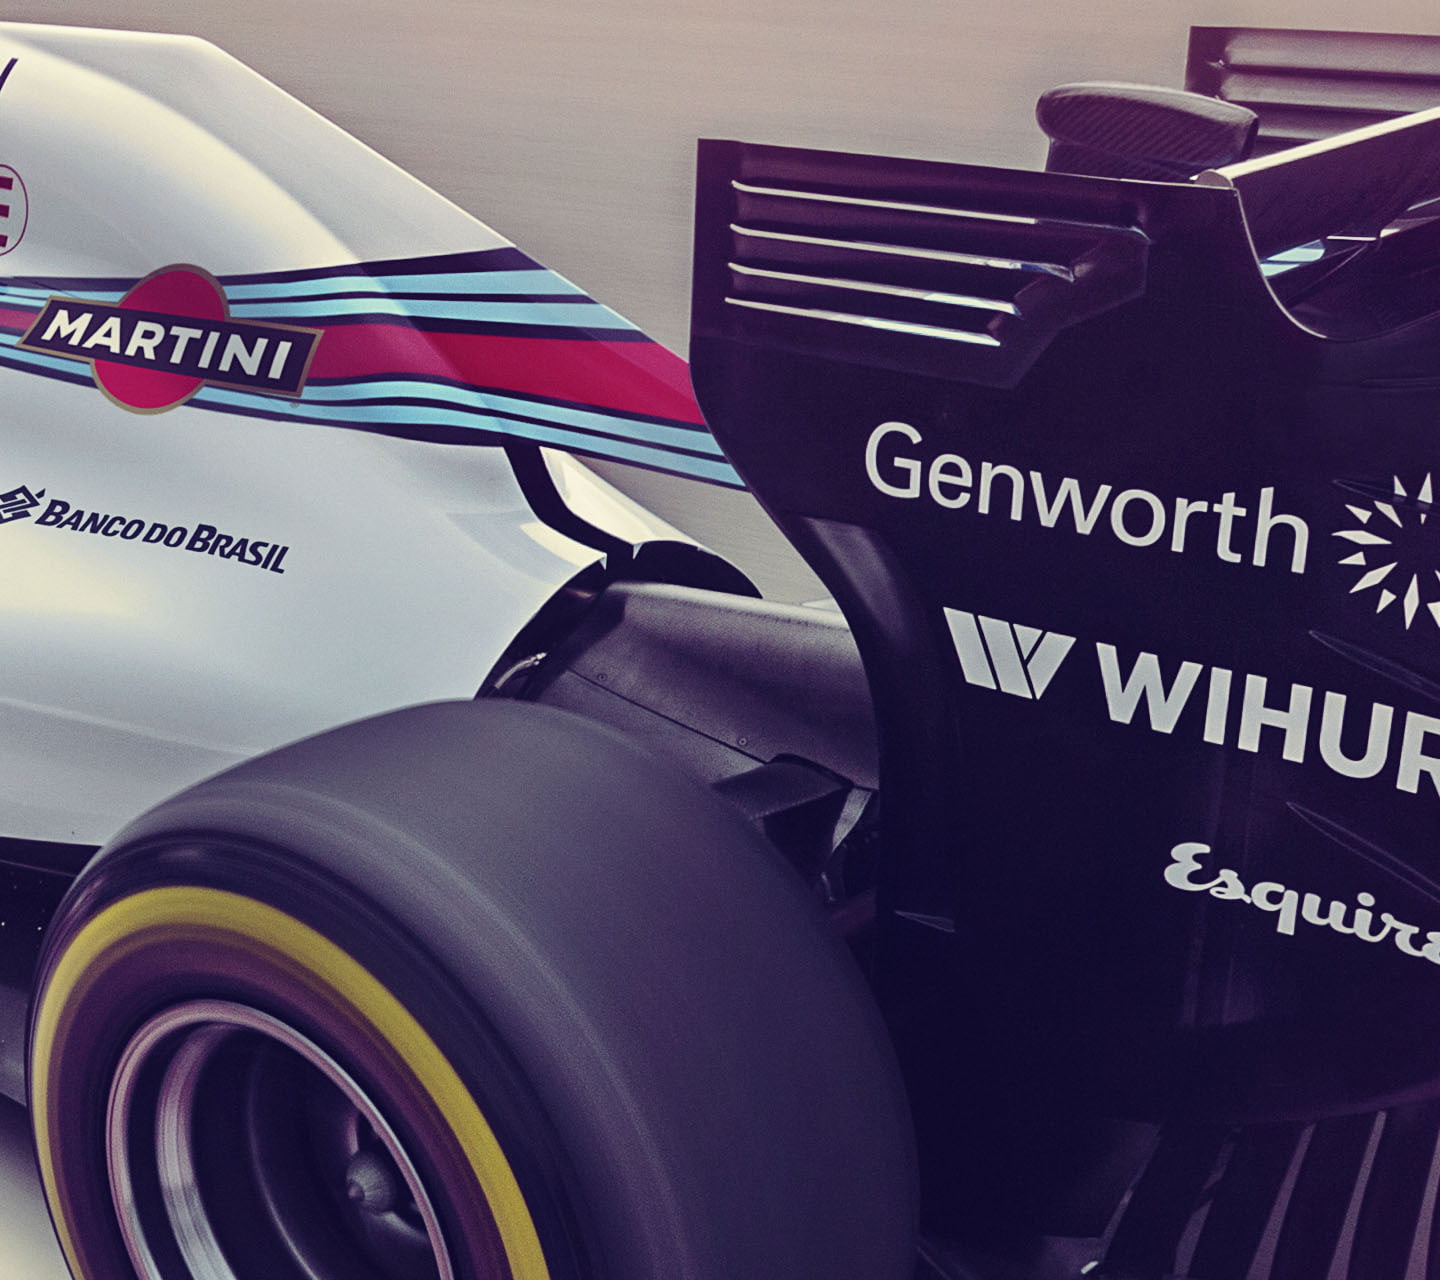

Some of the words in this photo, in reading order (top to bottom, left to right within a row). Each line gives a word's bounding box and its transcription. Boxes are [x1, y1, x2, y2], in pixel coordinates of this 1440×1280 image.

[41, 309, 292, 379] MARTINI
[865, 421, 1310, 574] Genworth
[34, 499, 146, 540] BANCO
[142, 522, 188, 548] DO
[185, 523, 289, 574] BRASIL
